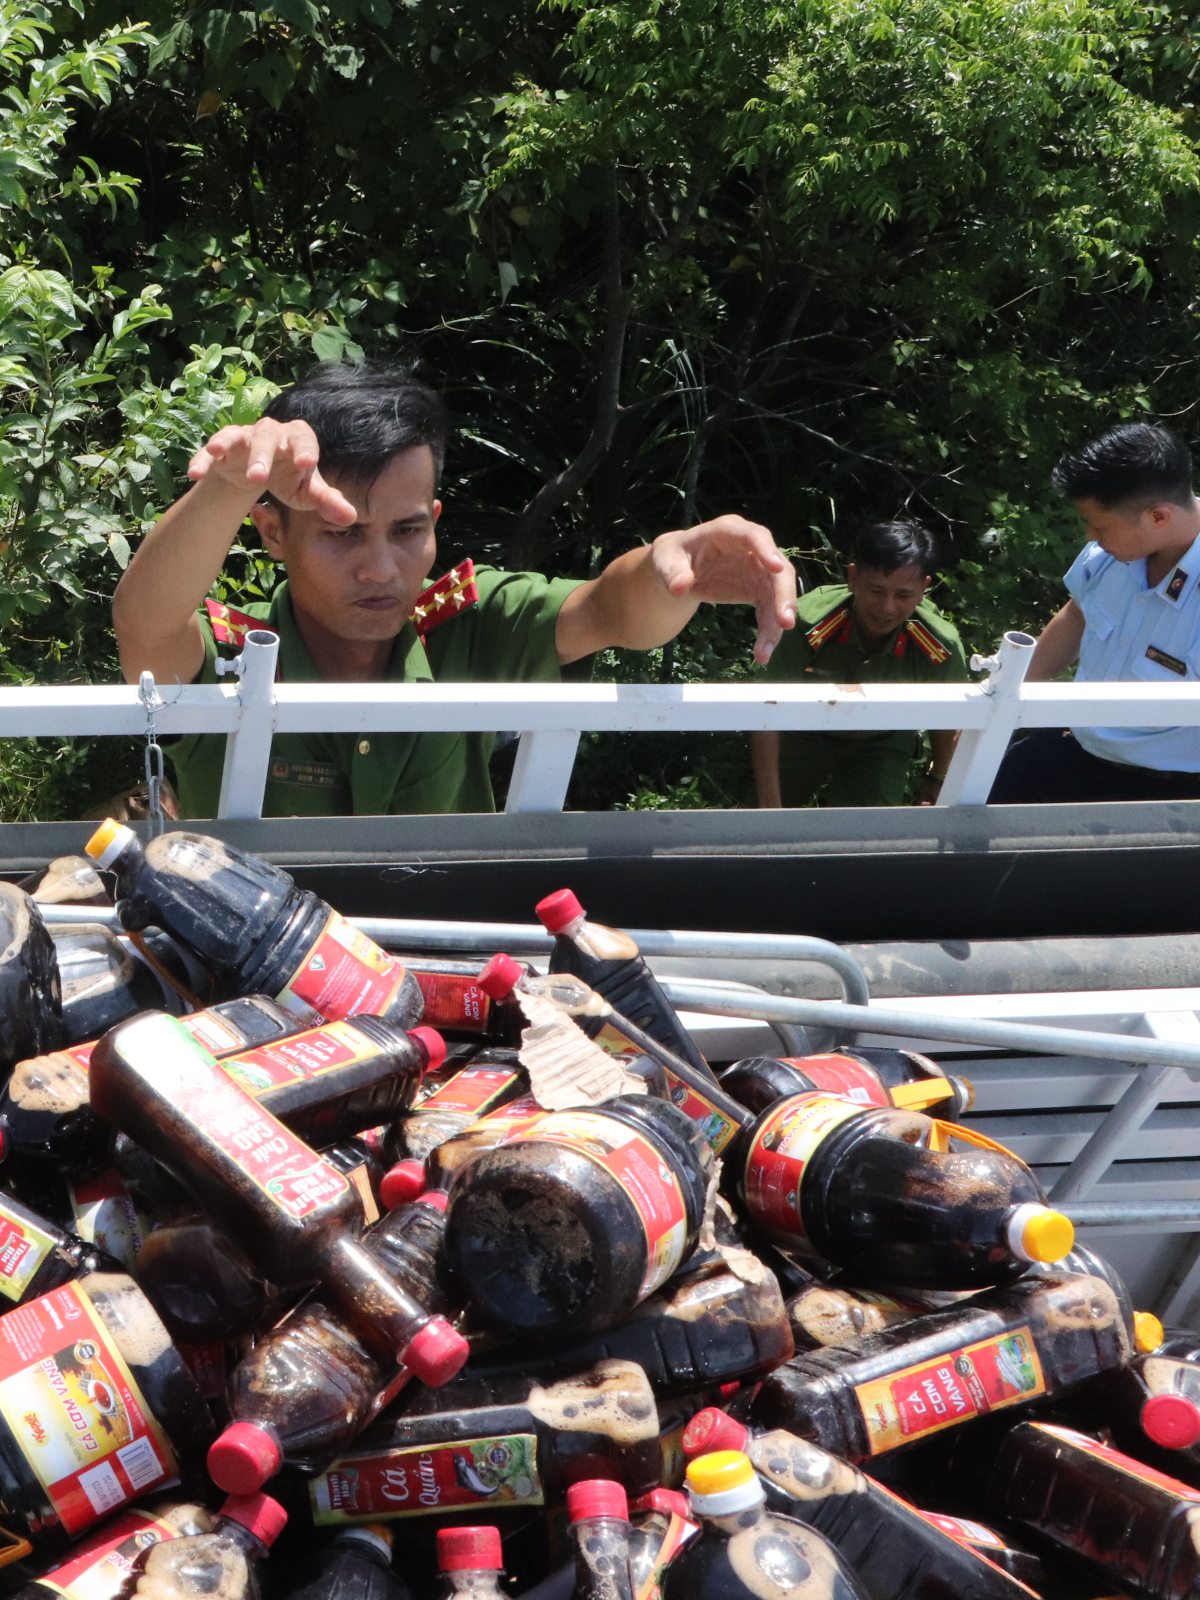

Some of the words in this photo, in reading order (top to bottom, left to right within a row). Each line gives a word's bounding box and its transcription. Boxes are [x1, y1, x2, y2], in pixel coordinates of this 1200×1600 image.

[231, 1126, 275, 1151] CAO
[3, 1241, 28, 1274] Thanh
[41, 1357, 70, 1396] VÀNG
[937, 1366, 968, 1413] VÀNG
[907, 1390, 928, 1415] CÁ
[921, 1378, 948, 1416] CƠM
[61, 1398, 90, 1431] CƠM
[78, 1436, 99, 1452] CÁ
[331, 1474, 343, 1507] Thanh
[380, 1466, 410, 1501] Cá
